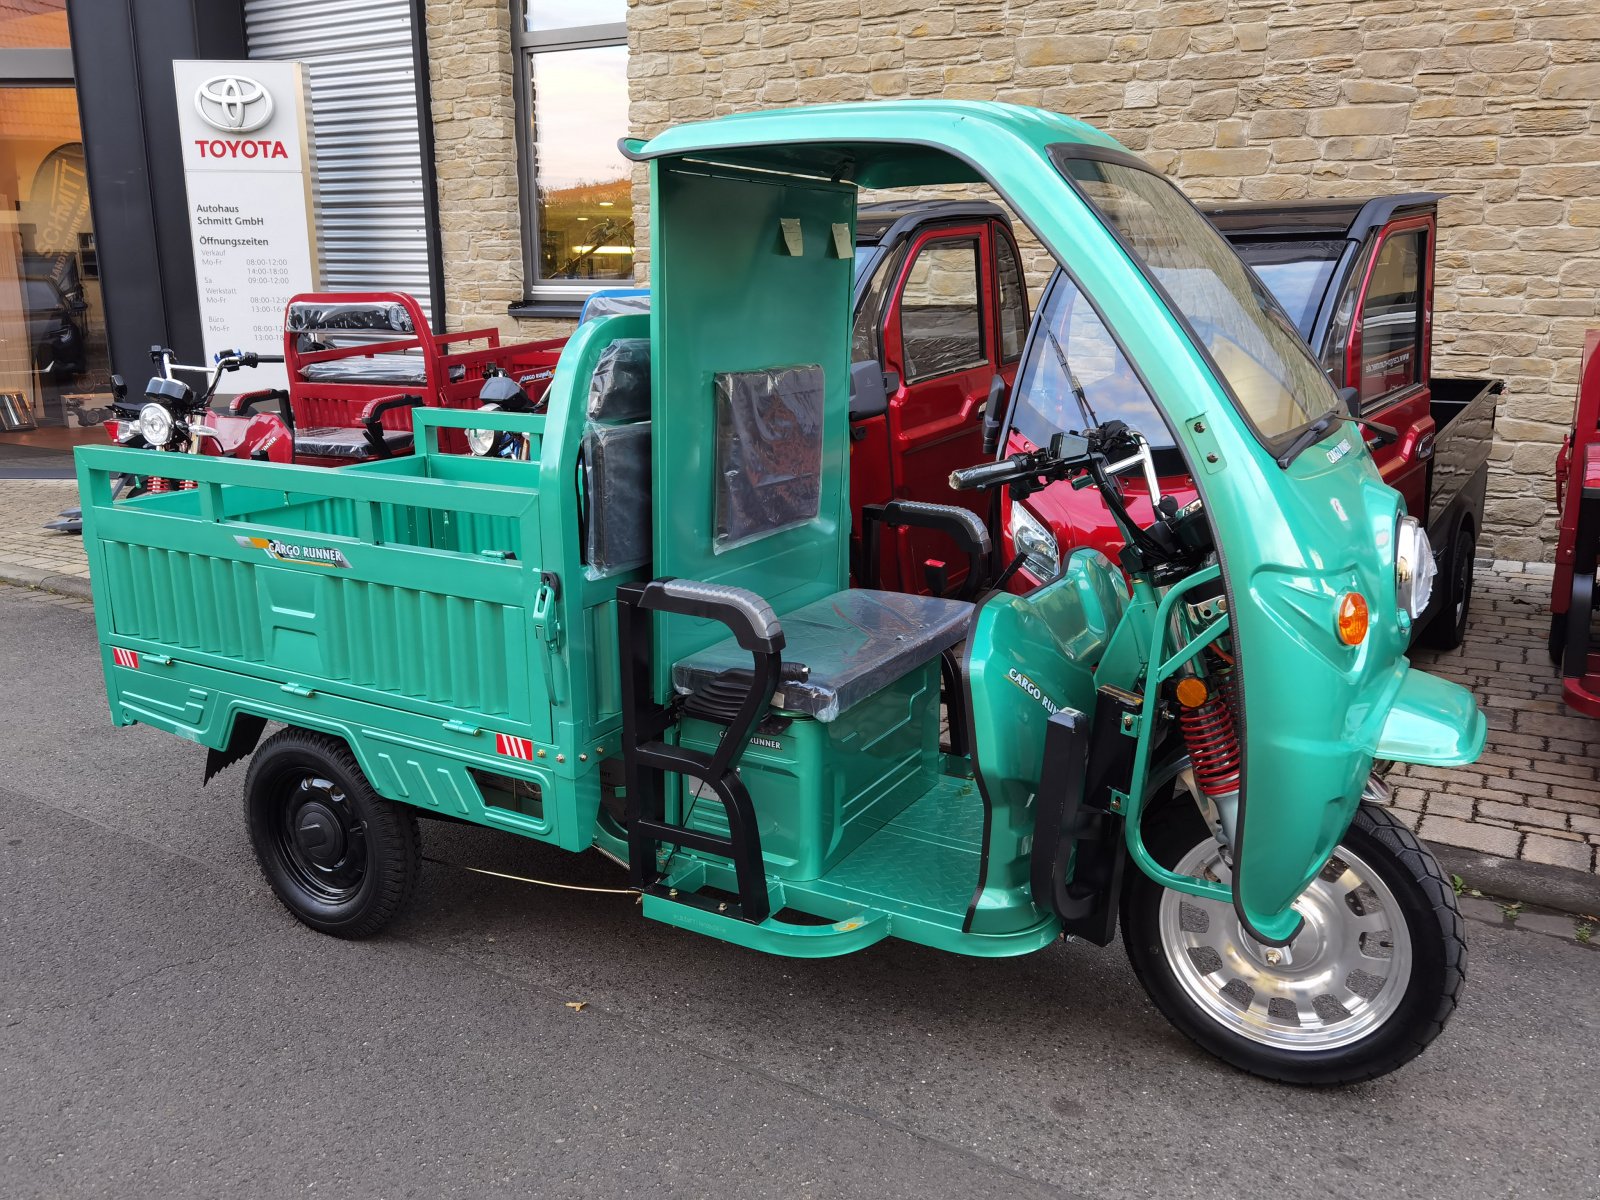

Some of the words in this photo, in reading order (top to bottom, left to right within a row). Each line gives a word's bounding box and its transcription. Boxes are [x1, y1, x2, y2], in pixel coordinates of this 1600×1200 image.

[195, 140, 288, 158] TOYOTA
[36, 159, 85, 258] SCHMITT
[196, 204, 239, 213] Autohaus
[197, 216, 232, 225] Schmitt
[235, 217, 264, 226] GmbH
[199, 236, 269, 247] Öffnungszeiten
[201, 249, 226, 257] Verkauf
[246, 258, 288, 266] 08:00-12:00
[205, 287, 237, 295] Werkstatt
[268, 542, 300, 556] CARGO
[303, 548, 342, 561] RUNNER
[1008, 668, 1041, 700] CARGO
